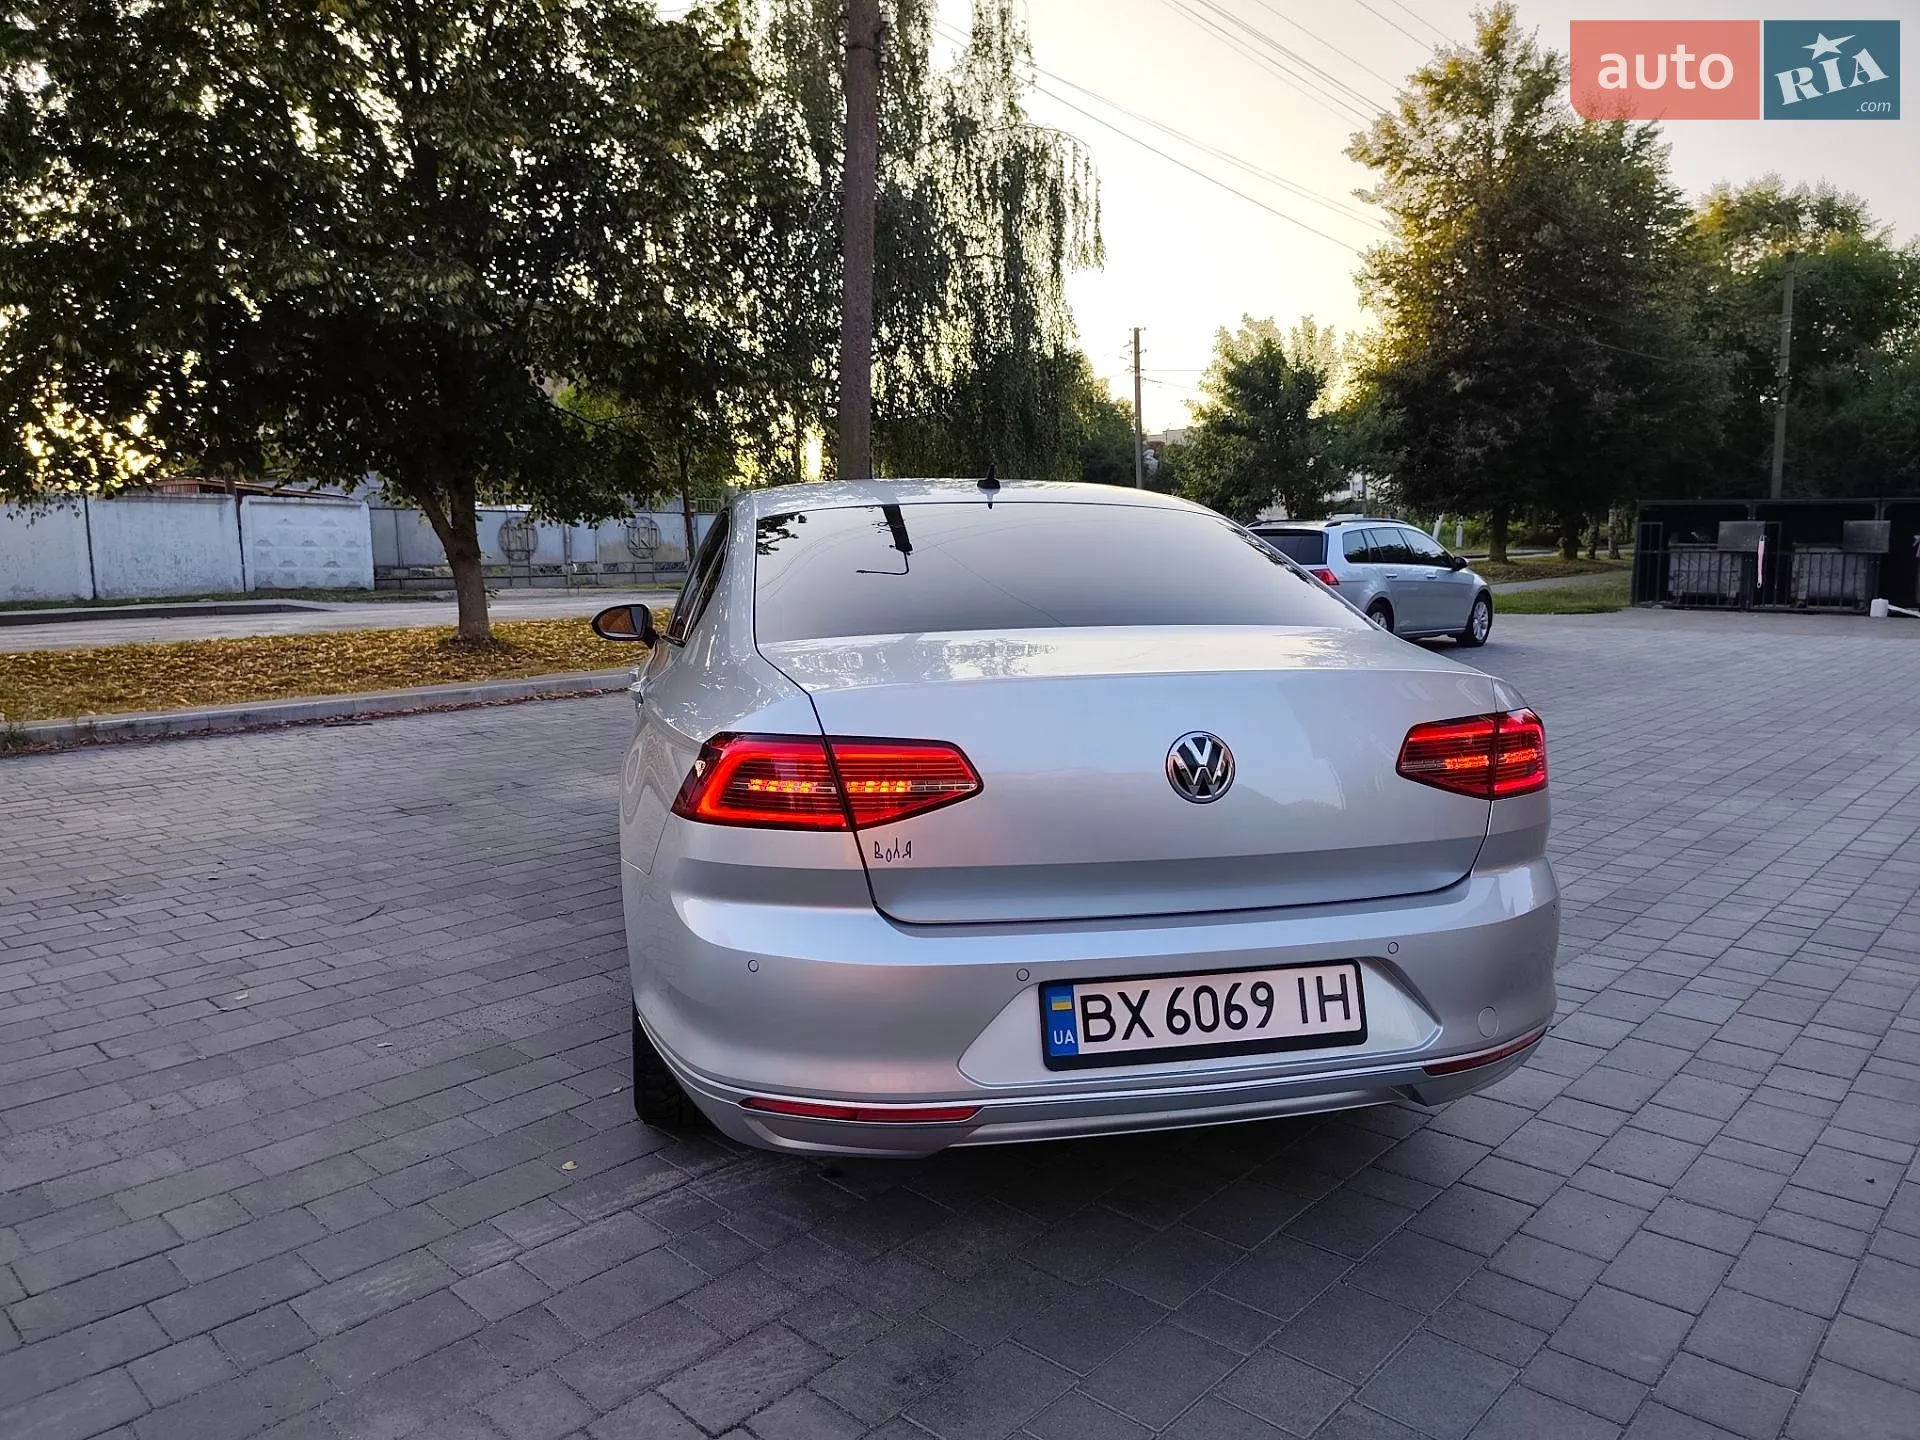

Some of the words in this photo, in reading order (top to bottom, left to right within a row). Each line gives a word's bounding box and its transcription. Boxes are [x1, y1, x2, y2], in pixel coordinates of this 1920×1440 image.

[1079, 989, 1155, 1043] BX
[1166, 981, 1275, 1035] 6069
[1297, 973, 1351, 1024] IH
[1053, 1029, 1076, 1045] UA
